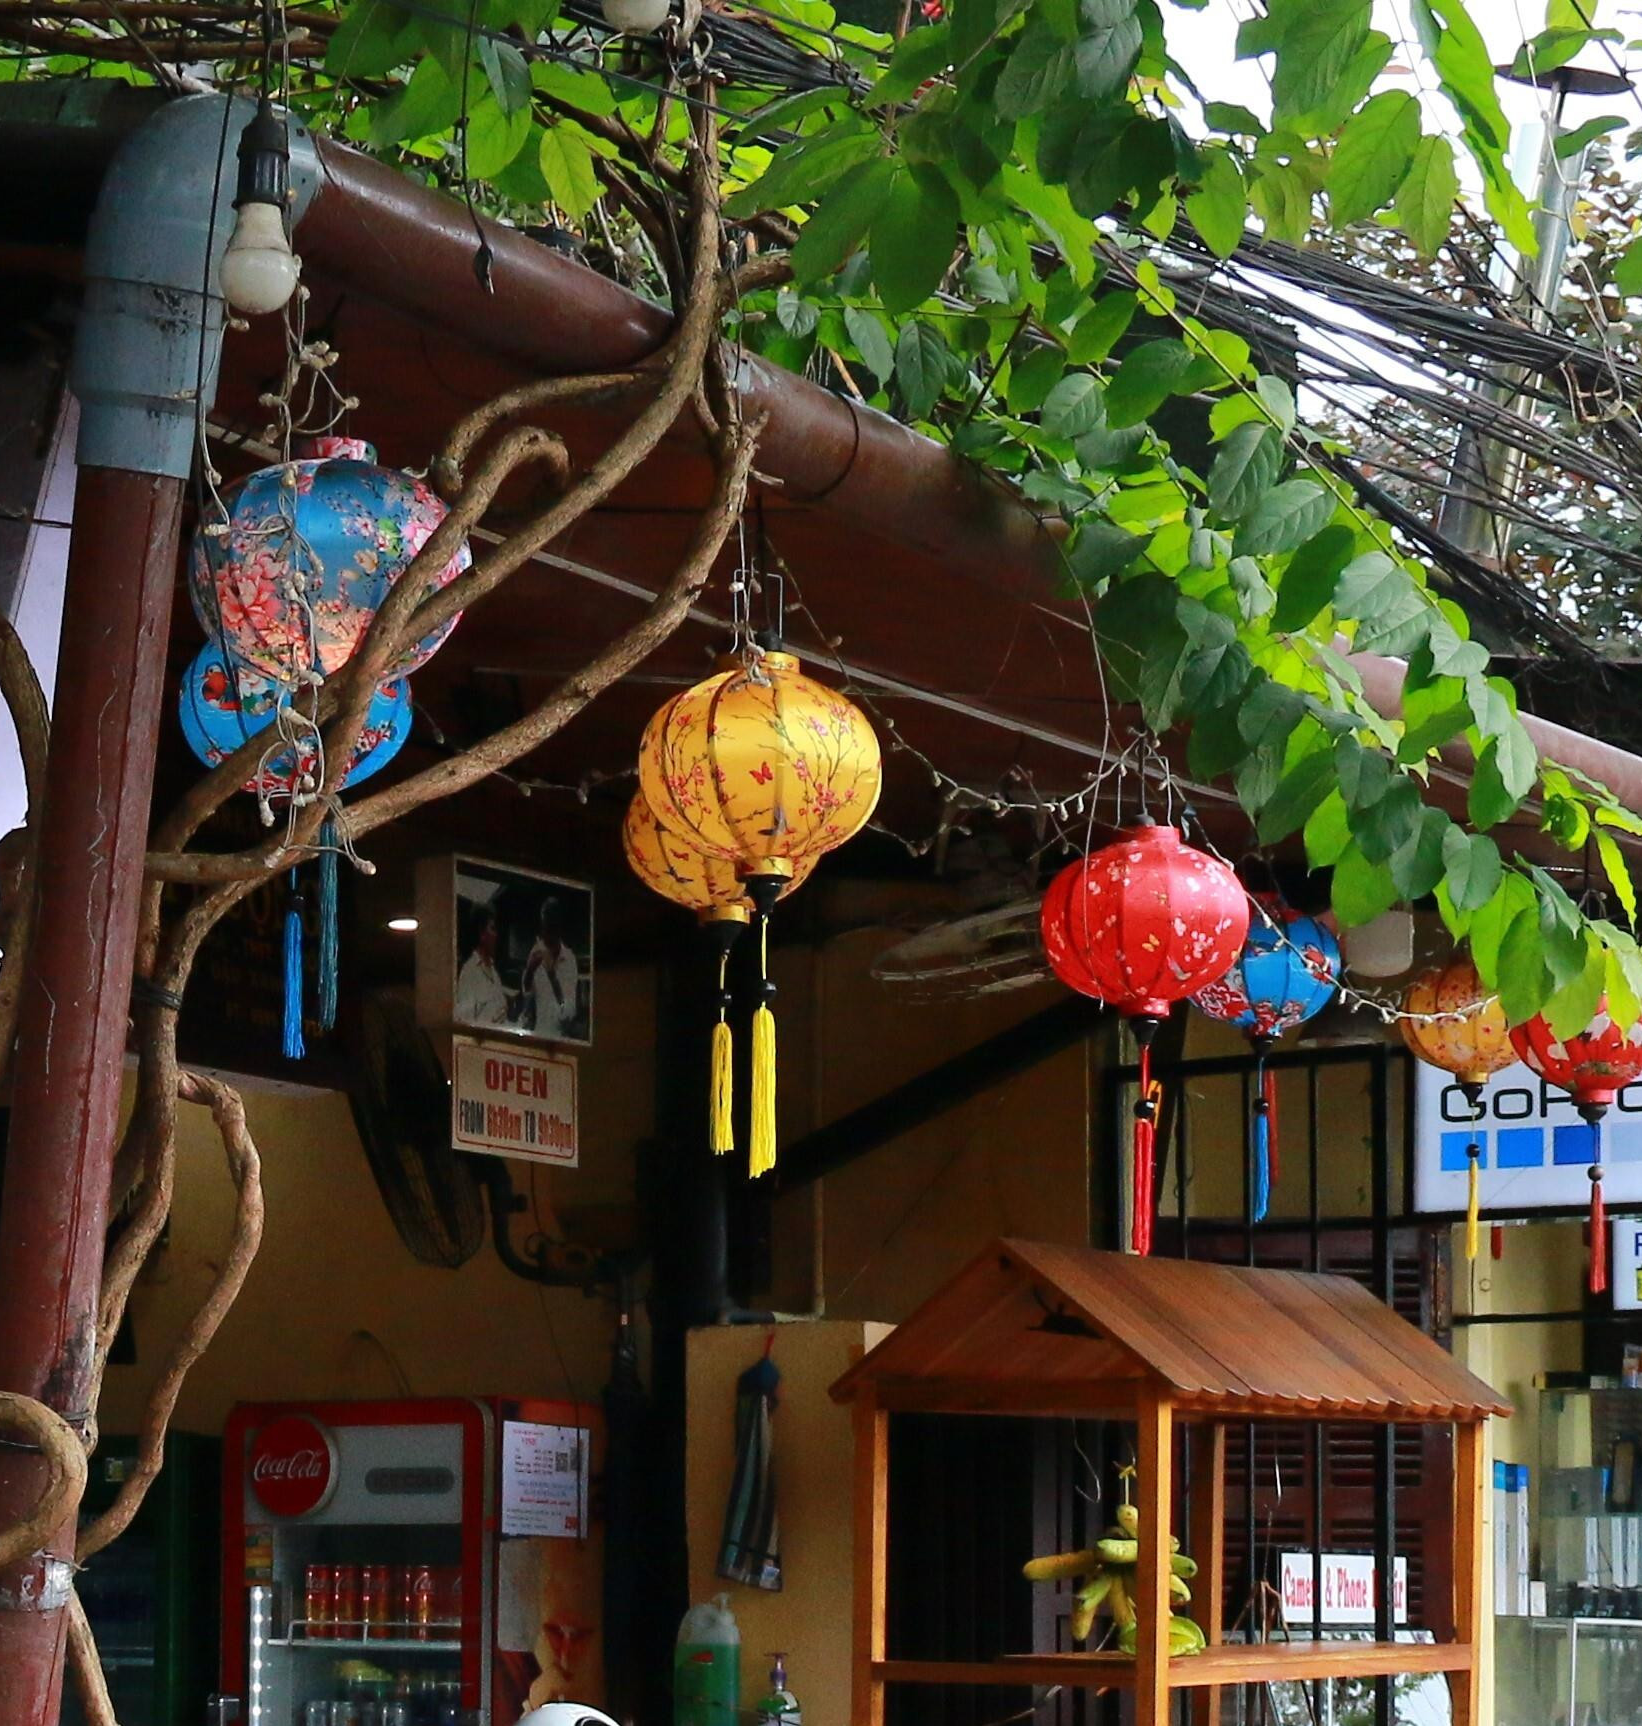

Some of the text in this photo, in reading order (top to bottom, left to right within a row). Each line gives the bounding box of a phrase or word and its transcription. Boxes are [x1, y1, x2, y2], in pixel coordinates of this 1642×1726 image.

[485, 1058, 548, 1099] OPEN
[459, 1099, 484, 1135] FROM
[524, 1110, 536, 1144] TO
[1325, 1565, 1333, 1608] &
[1336, 1567, 1367, 1608] Phone
